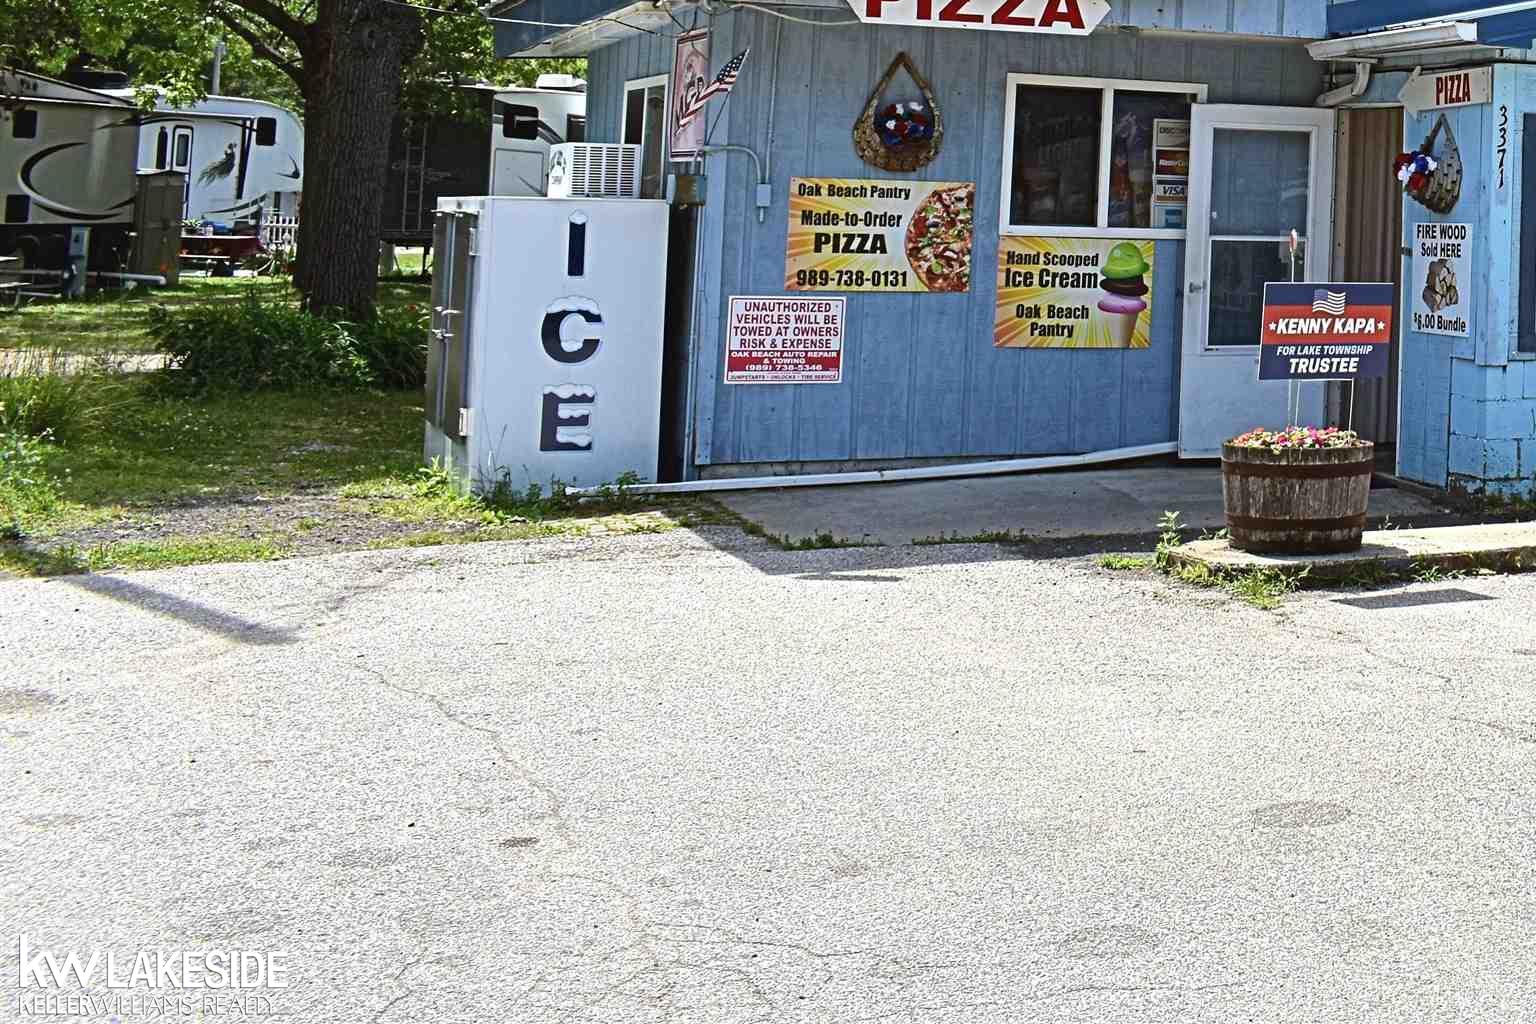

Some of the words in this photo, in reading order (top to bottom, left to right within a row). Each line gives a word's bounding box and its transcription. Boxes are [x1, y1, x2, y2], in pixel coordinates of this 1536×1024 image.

[1435, 72, 1471, 106] PIZZA
[1496, 105, 1508, 189] 3371
[798, 183, 822, 197] Oak
[828, 184, 867, 199] Beach
[870, 186, 911, 200] Pantry
[1162, 185, 1185, 195] VISA
[801, 210, 903, 228] Made-to-Order
[1416, 224, 1437, 240] FIRE
[1439, 225, 1467, 240] WOOD
[813, 232, 888, 255] PIZZA
[1421, 242, 1438, 257] Sold
[1440, 243, 1462, 258] HERE
[1006, 251, 1040, 265] Hand
[1043, 251, 1099, 268] Scooped
[796, 269, 908, 288] 989-738-0131
[1005, 267, 1034, 288] Ice
[1038, 268, 1098, 289] Cream
[744, 302, 832, 313] UNAUTHORIZED
[1015, 303, 1041, 319] Oak
[1047, 304, 1089, 320] Beach
[736, 314, 791, 325] VEHICLES
[794, 314, 820, 325] WILL
[823, 314, 838, 325] BE
[1276, 318, 1332, 335] KENNY
[1333, 317, 1376, 334] KAPA
[1414, 312, 1436, 330] $6.00
[1437, 316, 1466, 332] Bundle
[540, 209, 603, 452] ICE
[733, 326, 773, 337] TOWED
[775, 326, 790, 337] AT
[793, 326, 839, 337] OWNERS
[1029, 322, 1074, 338] Pantry
[740, 338, 766, 349] RISK
[770, 338, 778, 349] &
[781, 338, 832, 349] EXPENSE
[1276, 346, 1295, 356] FOR
[1297, 345, 1322, 356] LAKE
[1323, 345, 1374, 355] TOWNSHIP
[1289, 357, 1360, 374] TRUSTEE
